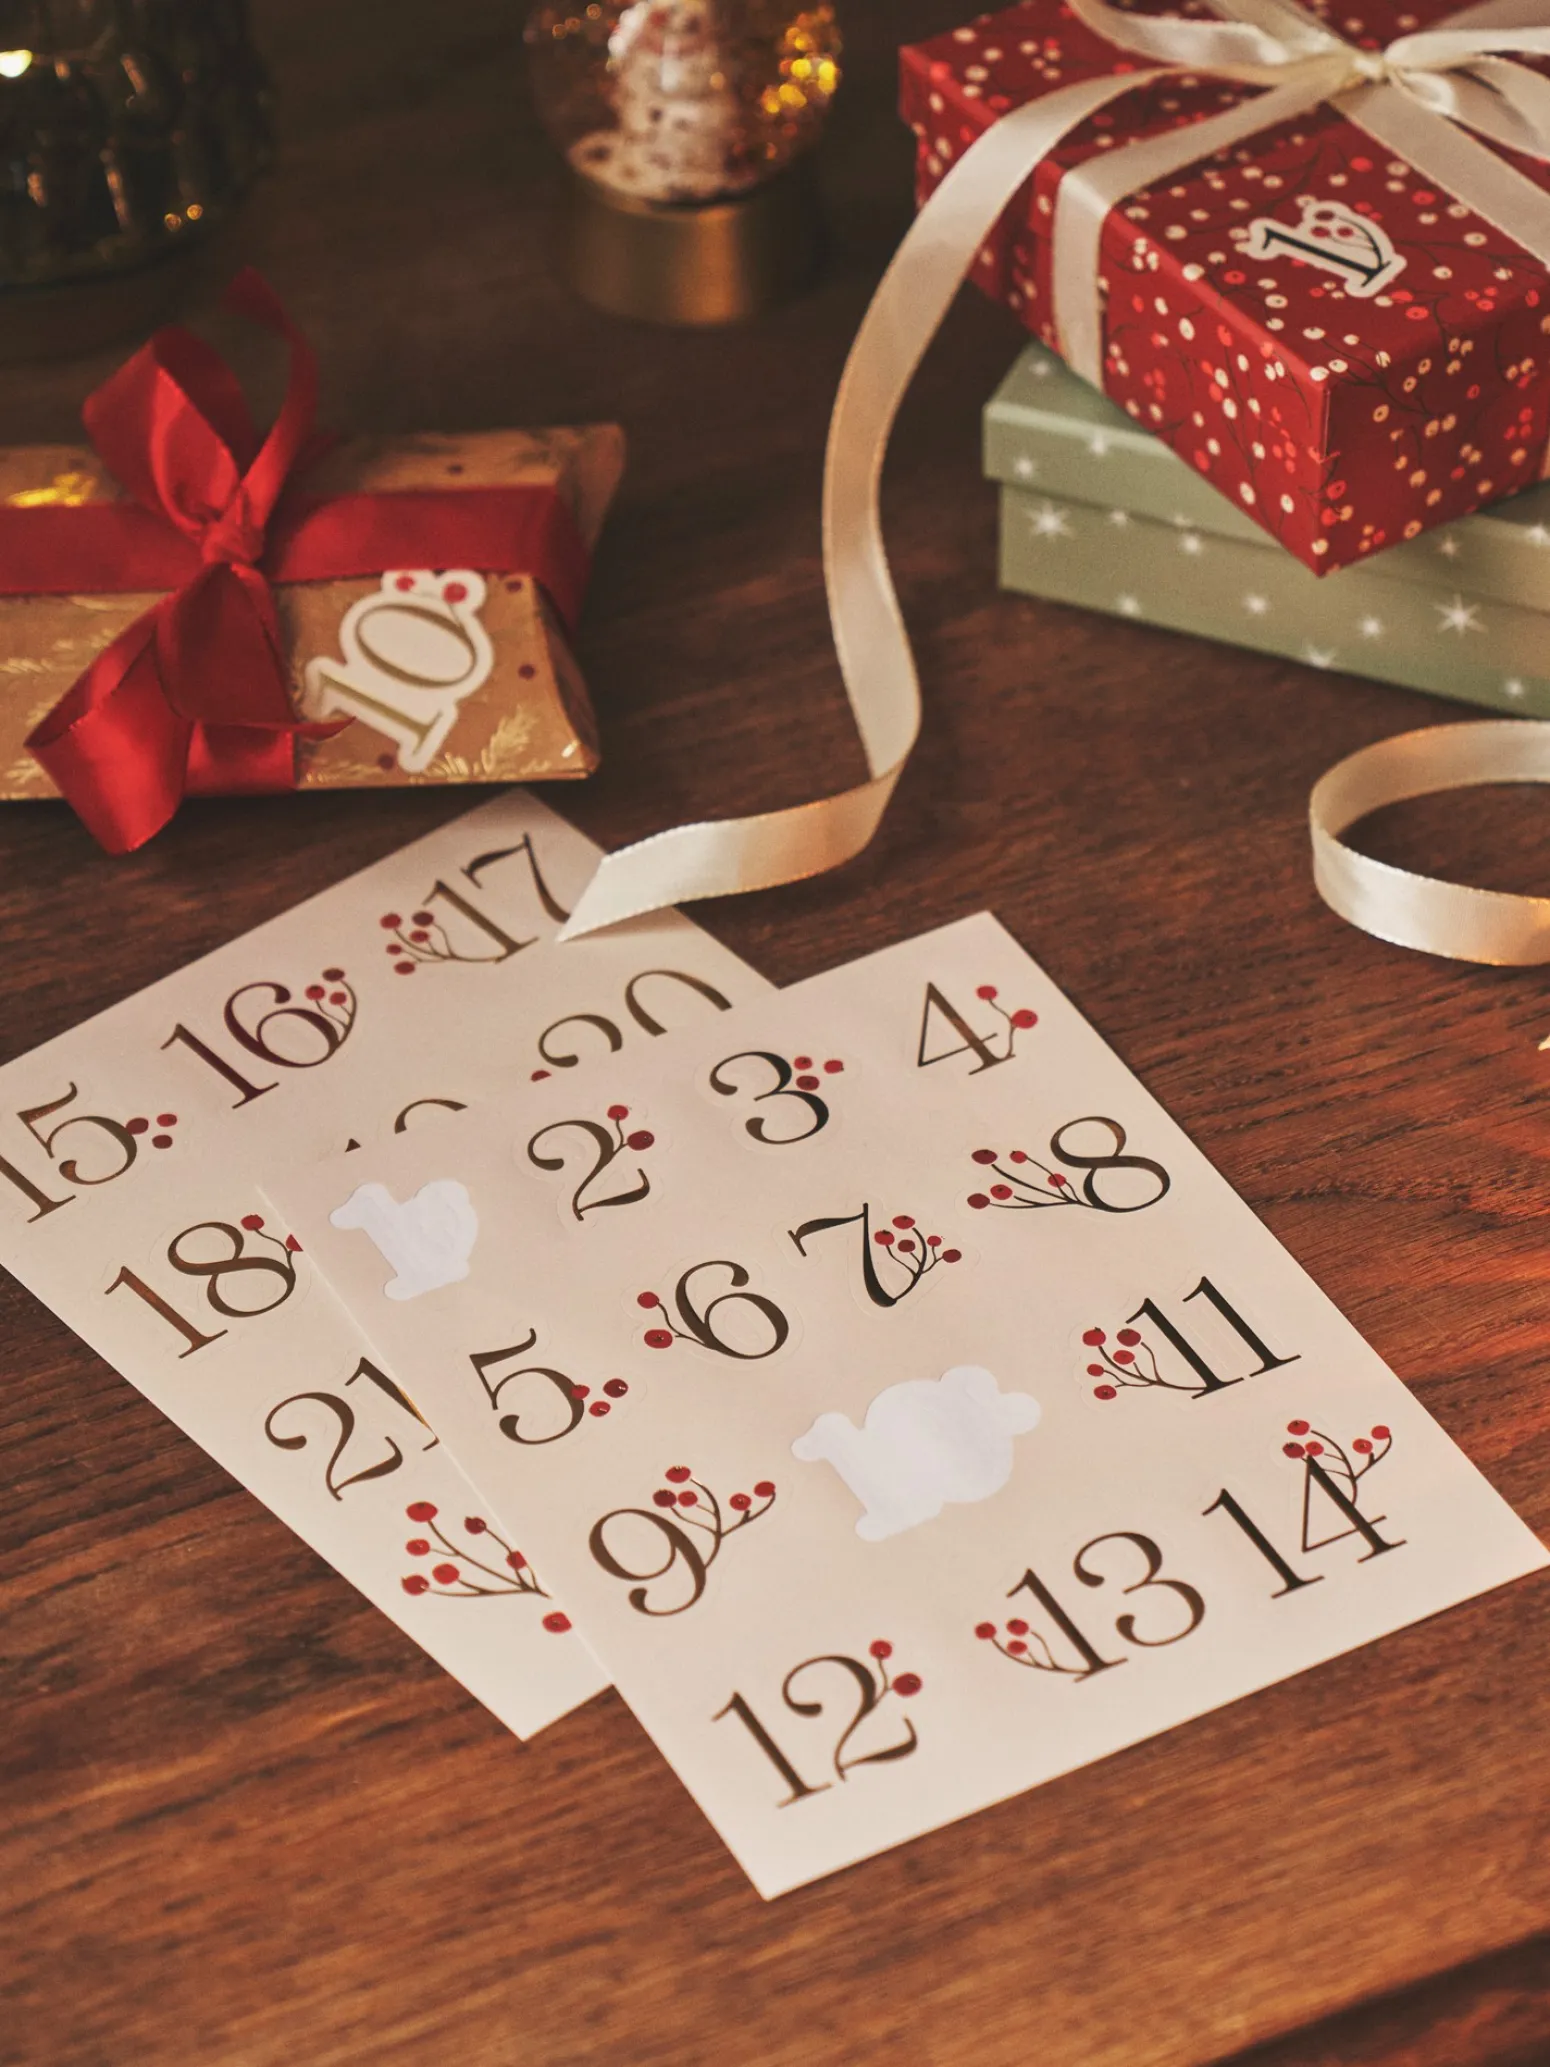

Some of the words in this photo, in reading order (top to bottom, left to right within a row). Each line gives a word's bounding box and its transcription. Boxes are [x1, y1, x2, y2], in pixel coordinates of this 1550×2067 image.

[1262, 226, 1391, 288] 1
[313, 602, 477, 756] 10
[423, 832, 572, 964] 17
[160, 981, 343, 1109] 16
[917, 981, 1016, 1075] 4
[0, 1081, 138, 1224] 15
[709, 1050, 829, 1145] 3
[526, 1119, 651, 1221] 2
[1050, 1115, 1171, 1213] 8
[104, 1220, 296, 1359] 18
[675, 1259, 789, 1360] 6
[787, 1202, 898, 1308] 7
[469, 1328, 584, 1445] 5
[1126, 1275, 1302, 1400] 11
[588, 1507, 707, 1616] 9
[1202, 1453, 1408, 1600] 14
[1005, 1531, 1206, 1682] 13
[711, 1654, 919, 1808] 12
